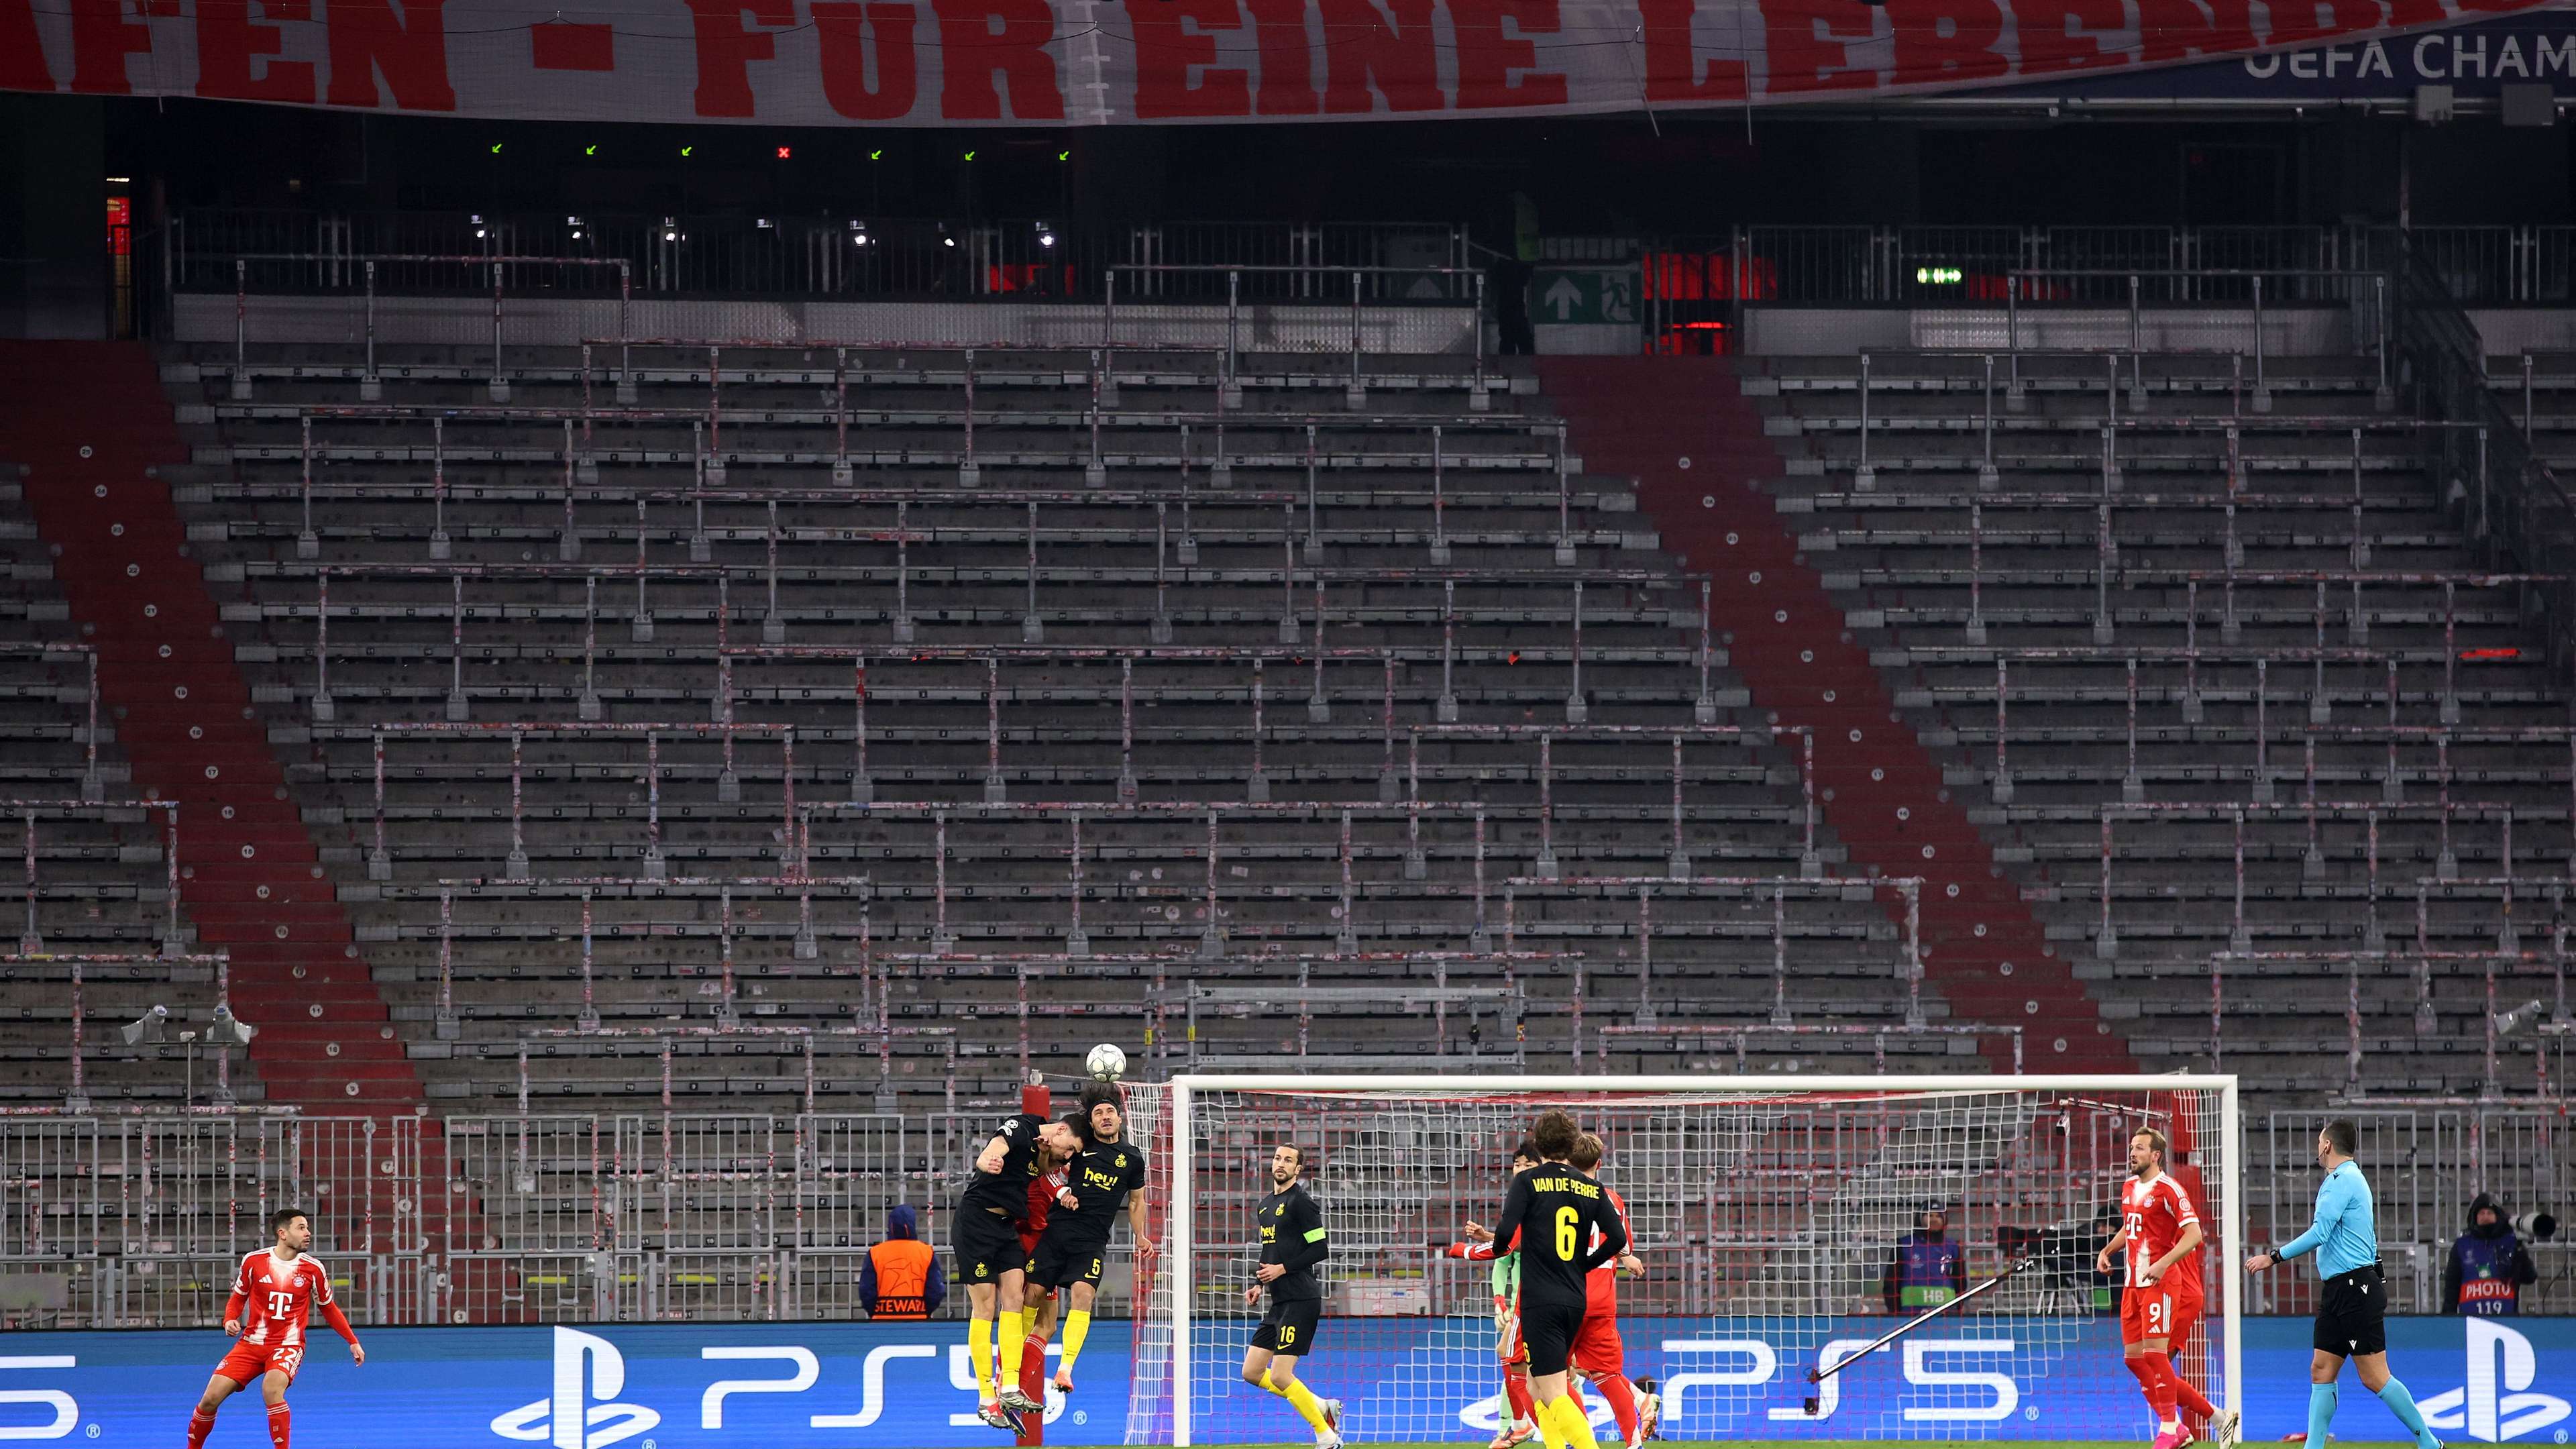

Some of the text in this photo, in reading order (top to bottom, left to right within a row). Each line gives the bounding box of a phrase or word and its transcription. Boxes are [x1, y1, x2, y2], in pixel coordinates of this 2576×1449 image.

[1122, 0, 1568, 119] EINE
[2245, 34, 2576, 78] UEFA CHAM
[1084, 1167, 1118, 1187] hey!
[1532, 1177, 1599, 1199] VAN DE PERRE
[1260, 1224, 1276, 1240] hey!
[1556, 1205, 1578, 1262] 6
[1092, 1258, 1102, 1275] 5
[1923, 1289, 1945, 1303] HB
[2148, 1302, 2161, 1324] 9
[2476, 1301, 2502, 1315] 119
[1281, 1326, 1296, 1344] 16
[272, 1347, 298, 1364] 22
[701, 1344, 1067, 1430] PS5
[1661, 1339, 2019, 1421] PS5
